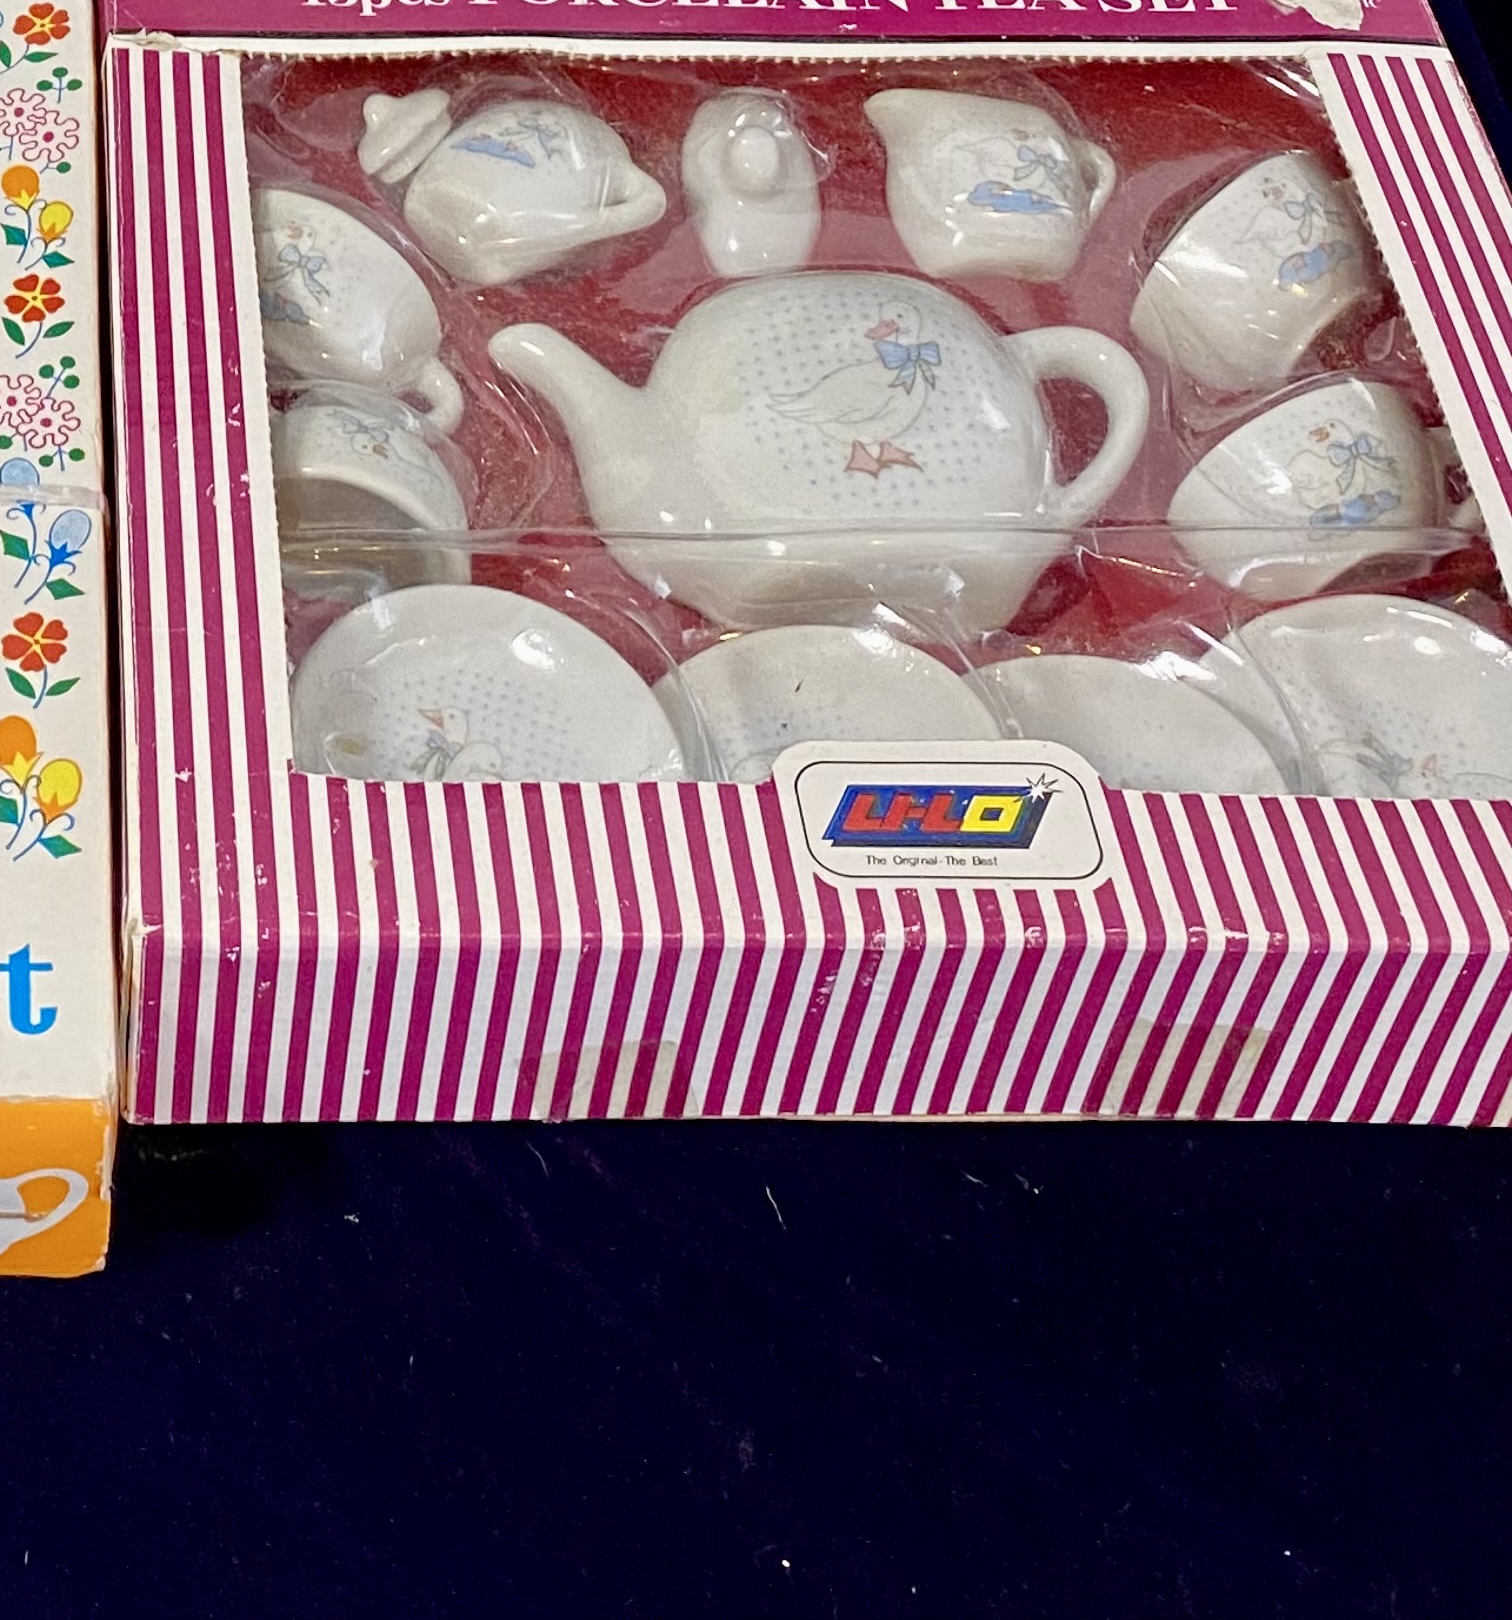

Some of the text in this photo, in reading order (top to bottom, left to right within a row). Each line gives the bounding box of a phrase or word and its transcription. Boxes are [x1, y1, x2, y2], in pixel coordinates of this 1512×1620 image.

[866, 855, 887, 866] The
[945, 855, 966, 866] The
[972, 856, 998, 867] Best
